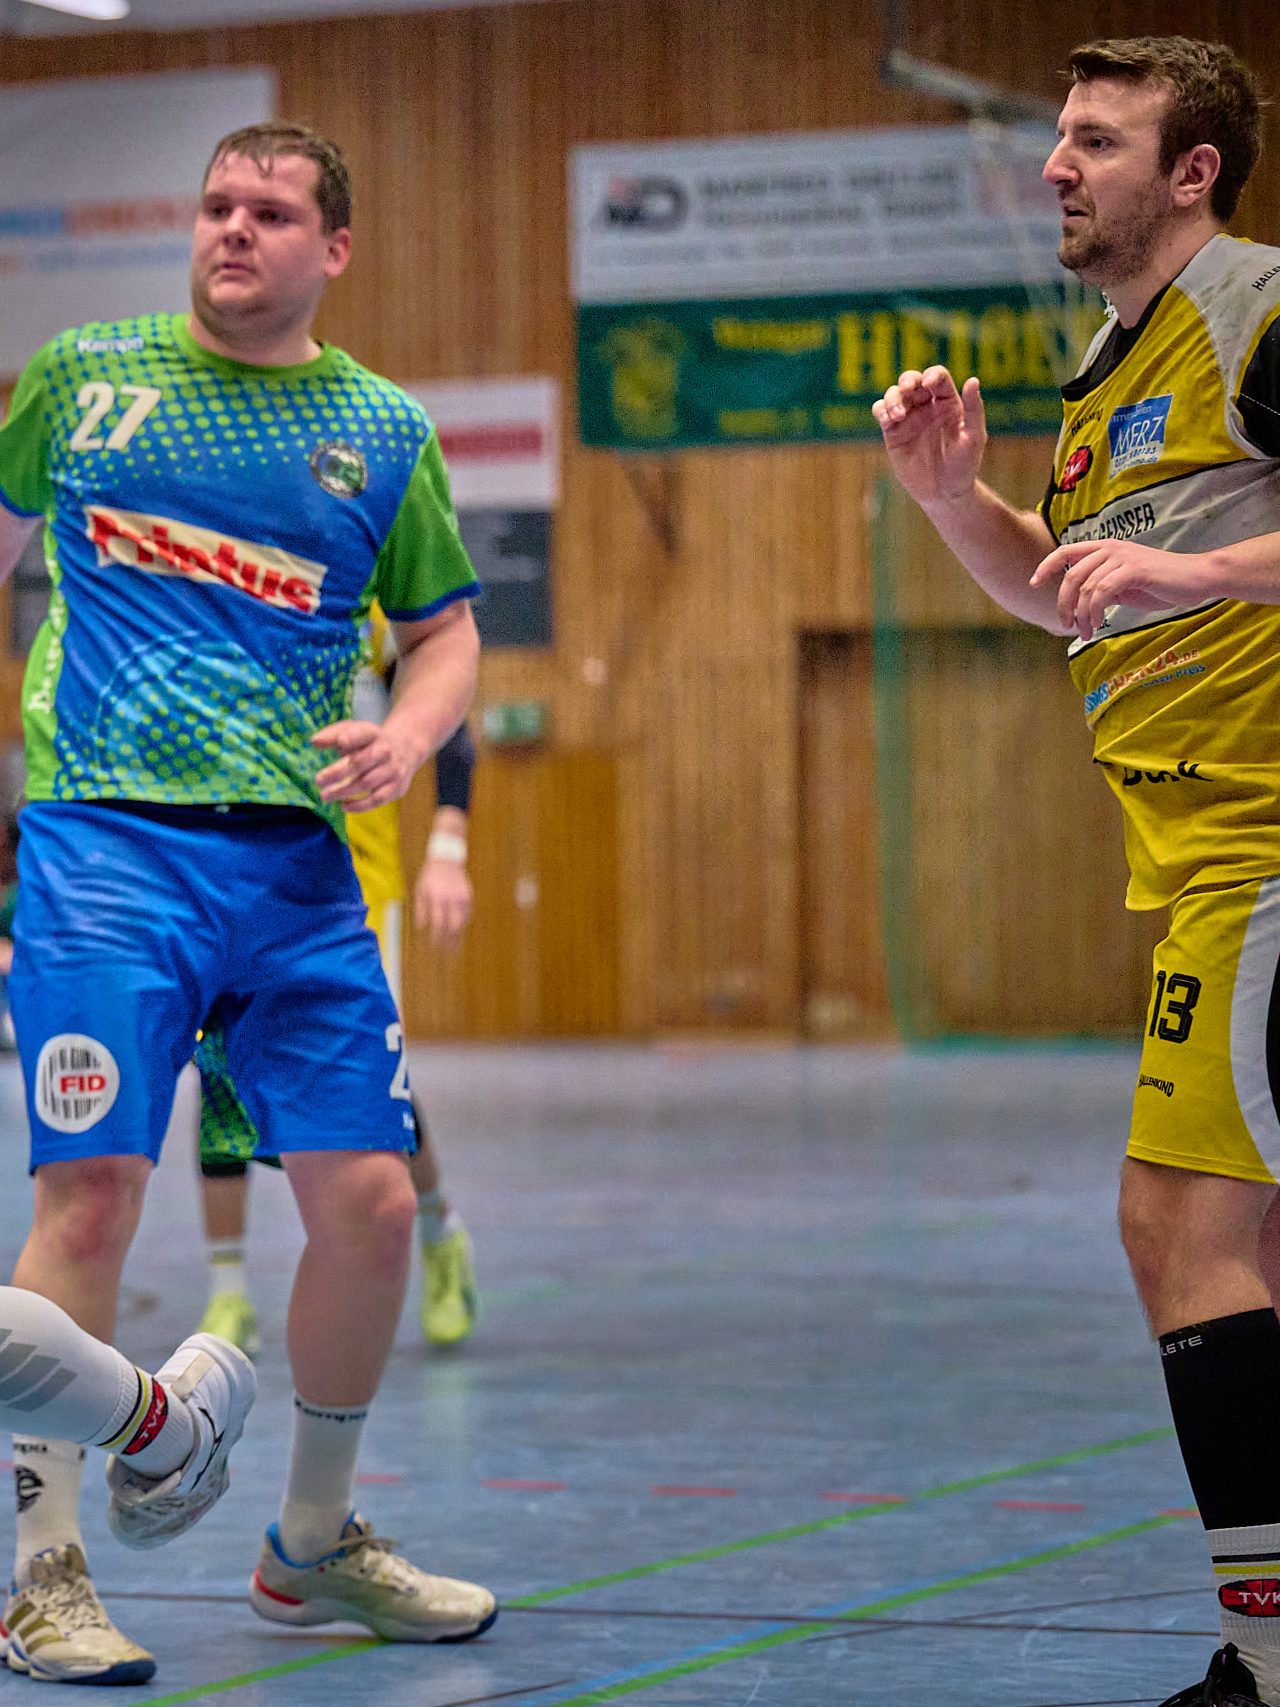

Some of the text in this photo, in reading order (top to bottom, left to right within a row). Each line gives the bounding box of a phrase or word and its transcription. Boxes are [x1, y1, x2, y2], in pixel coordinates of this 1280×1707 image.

[70, 382, 162, 452] 27
[1113, 415, 1164, 458] MERZ
[91, 512, 312, 612] Printus
[1148, 969, 1202, 1045] 13
[59, 1074, 107, 1095] FID
